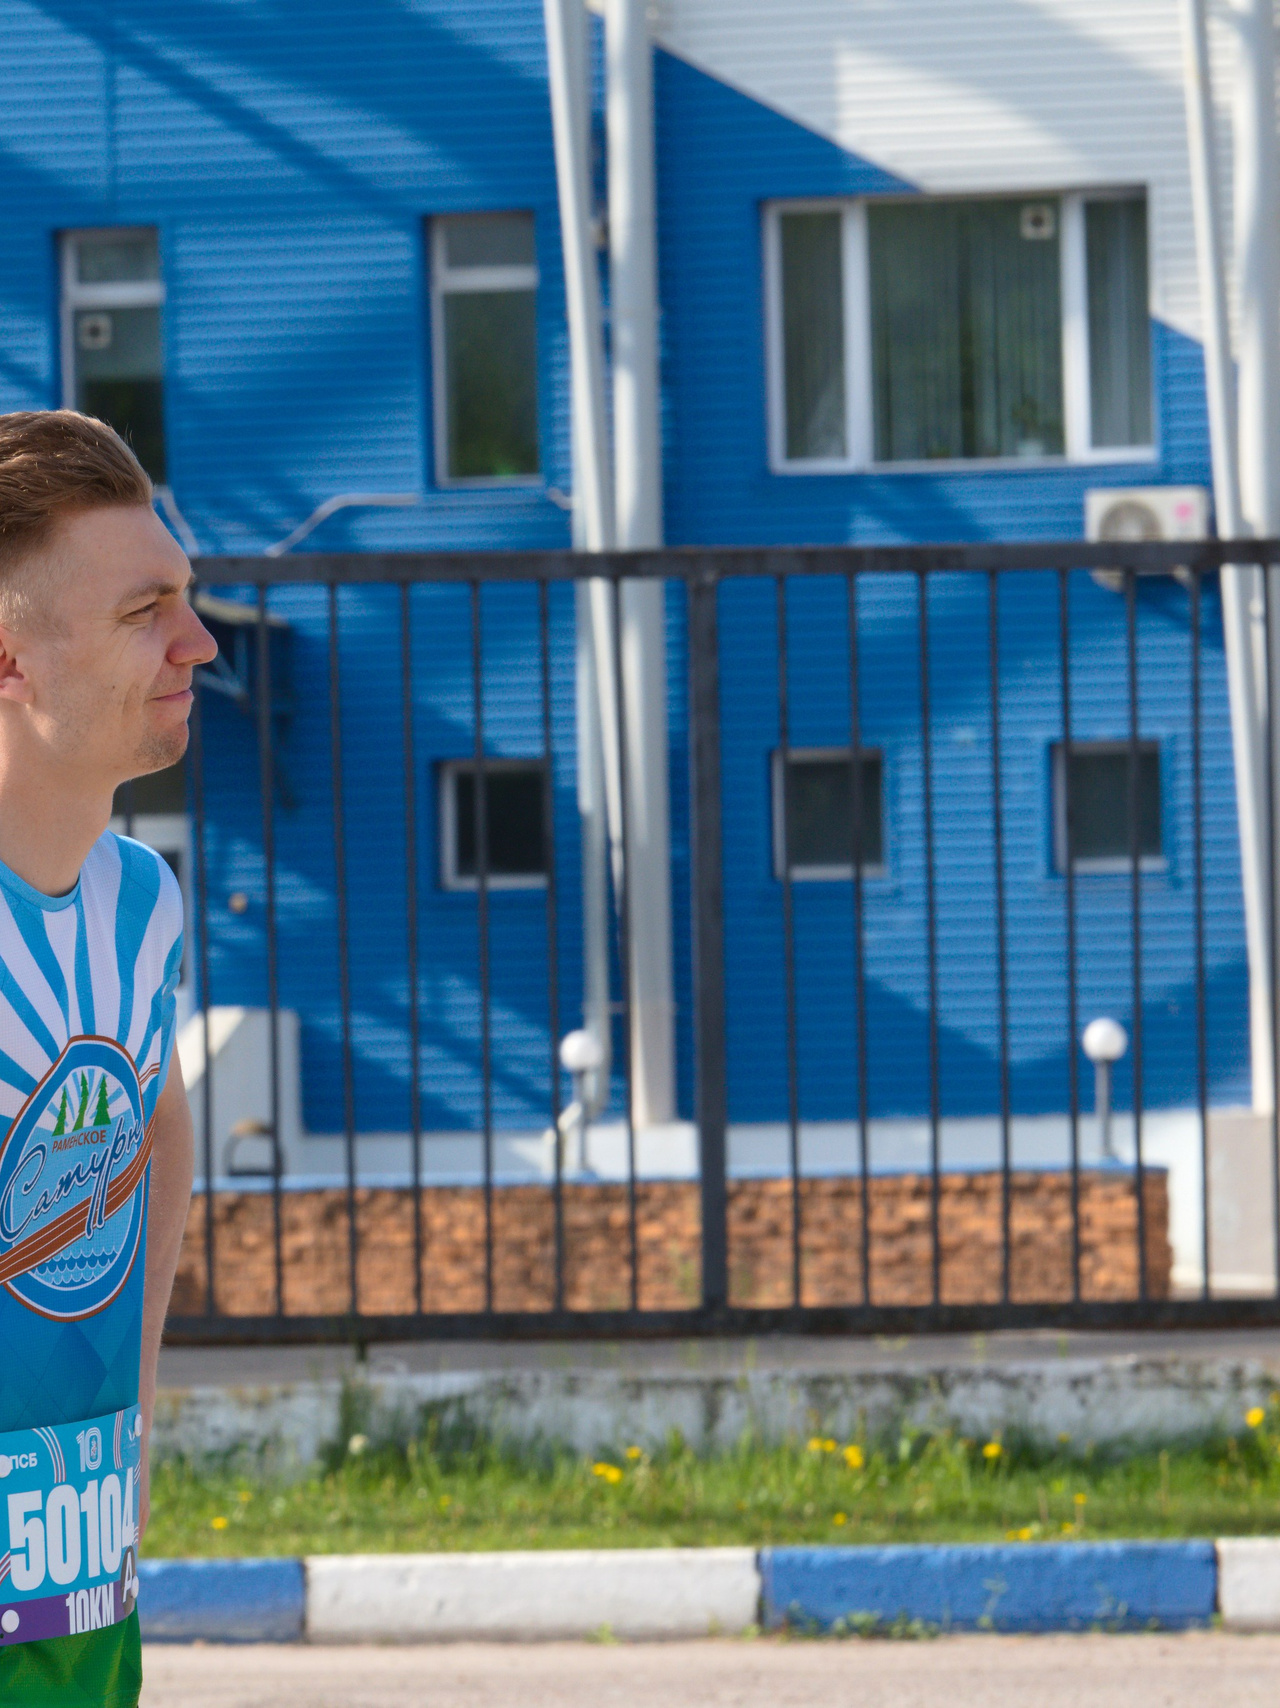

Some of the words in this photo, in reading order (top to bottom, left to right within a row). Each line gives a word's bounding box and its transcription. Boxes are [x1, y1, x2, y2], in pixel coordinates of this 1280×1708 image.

[51, 1129, 107, 1153] РАМЕНСКОЕ
[9, 1452, 38, 1470] ПСБ
[7, 1466, 135, 1592] 50104
